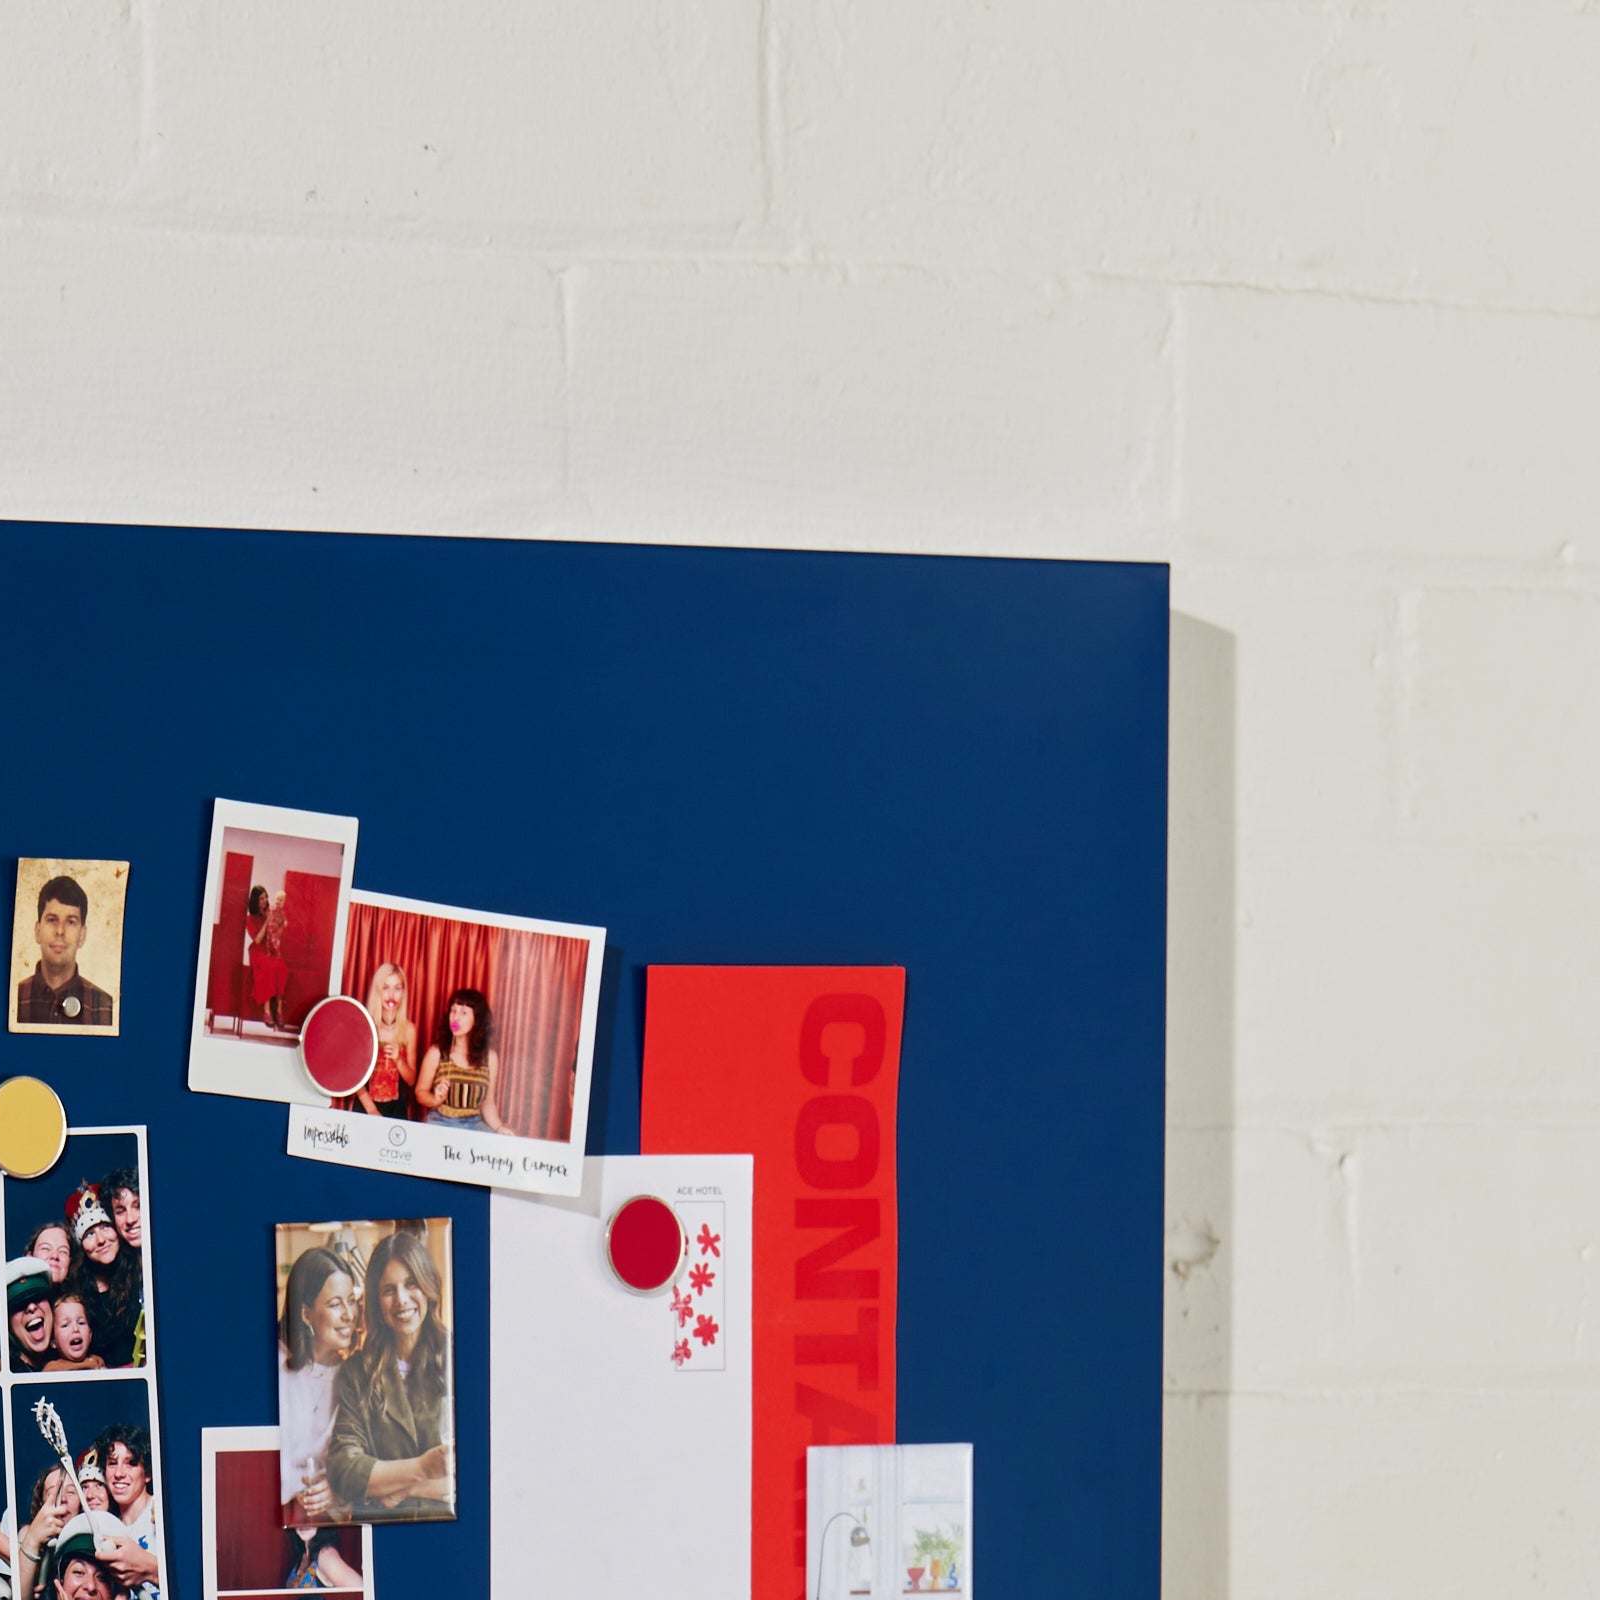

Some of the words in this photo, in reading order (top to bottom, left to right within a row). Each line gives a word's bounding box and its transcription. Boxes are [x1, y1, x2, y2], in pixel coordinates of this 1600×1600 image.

[379, 1147, 413, 1161] crave
[443, 1145, 463, 1160] The
[470, 1148, 514, 1175] Snappy
[522, 1156, 568, 1178] Camper
[676, 1186, 694, 1196] ACE
[695, 1186, 723, 1196] HOTEL
